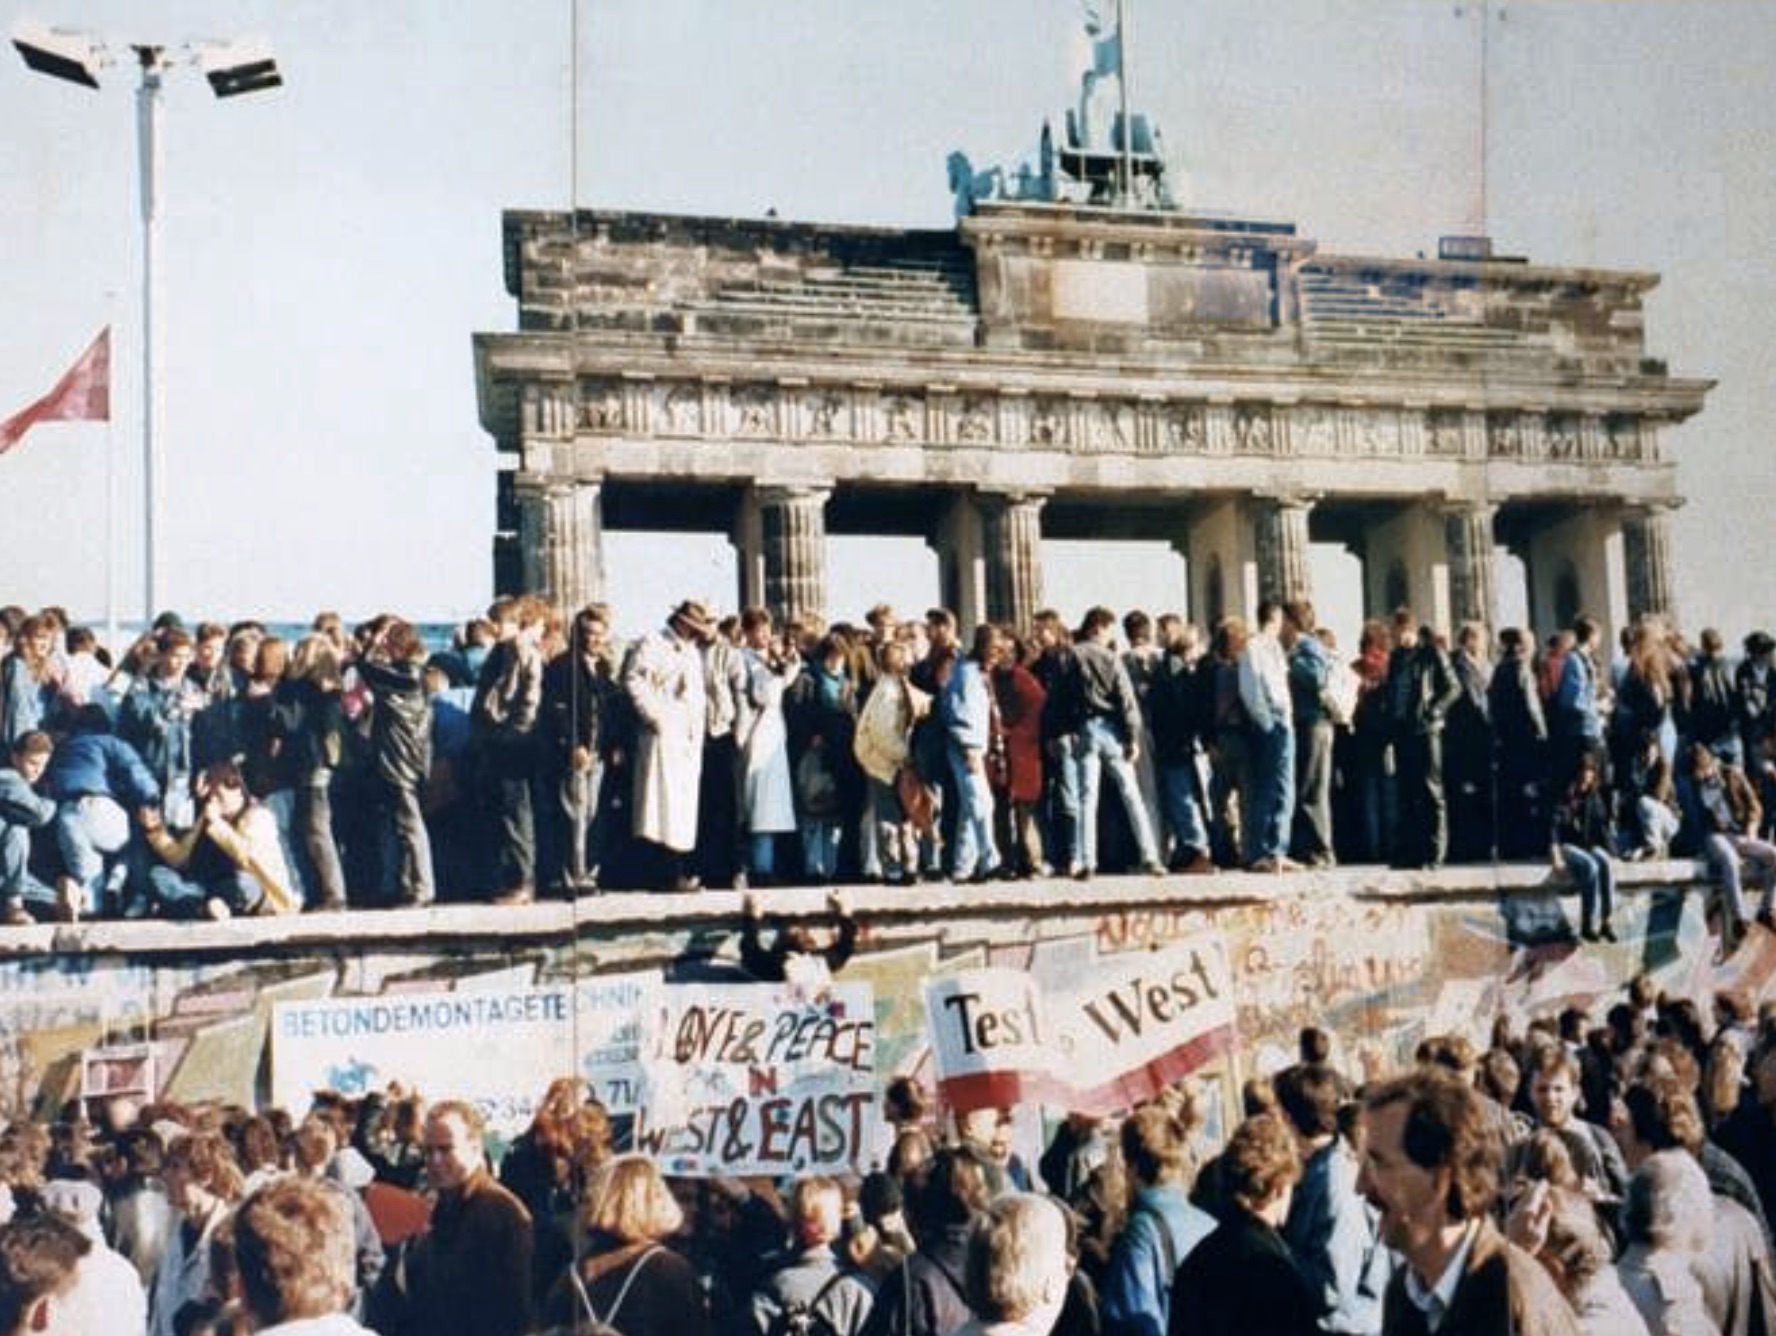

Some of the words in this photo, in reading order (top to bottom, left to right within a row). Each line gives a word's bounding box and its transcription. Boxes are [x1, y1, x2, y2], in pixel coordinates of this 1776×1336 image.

[945, 978, 1043, 1055] Test
[1082, 950, 1218, 1044] West
[766, 1010, 874, 1071] PEACE
[721, 1096, 754, 1164] &
